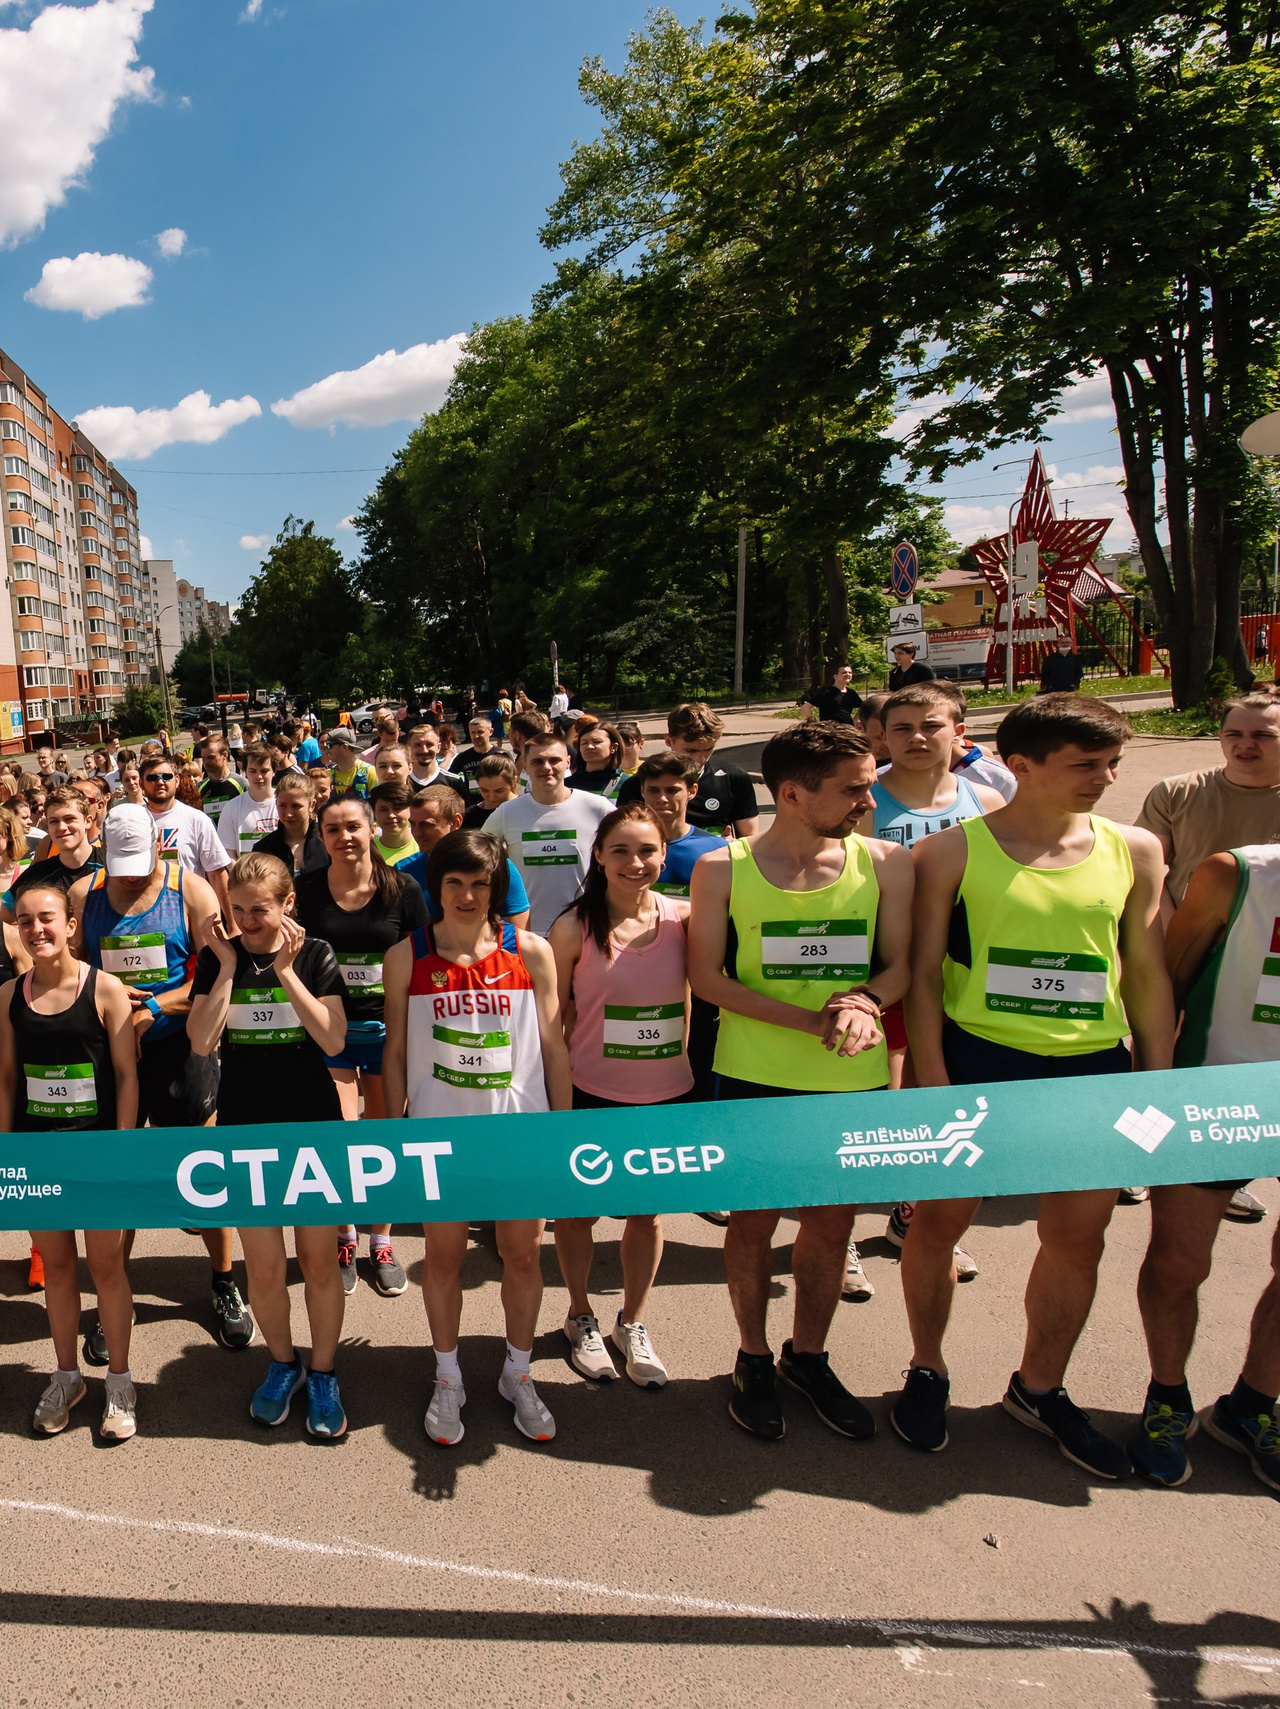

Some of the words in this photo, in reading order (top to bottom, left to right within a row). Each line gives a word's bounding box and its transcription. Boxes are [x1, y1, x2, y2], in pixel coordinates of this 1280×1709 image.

[541, 844, 557, 853] 404
[800, 944, 828, 957] 283
[122, 955, 142, 966] 172
[347, 971, 366, 981] 033
[1031, 977, 1066, 992] 375
[433, 992, 512, 1021] RUSSIA
[252, 1010, 274, 1023] 337
[637, 1028, 661, 1040] 336
[458, 1054, 482, 1067] 341
[47, 1086, 68, 1097] 343
[1183, 1103, 1260, 1123] Вклад
[841, 1123, 933, 1146] ЗЕЛЁНЫЙ
[1189, 1127, 1204, 1143] в
[623, 1143, 726, 1176] СБЕР
[839, 1150, 938, 1169] МАРАФОН
[176, 1140, 453, 1209] СТАРТ
